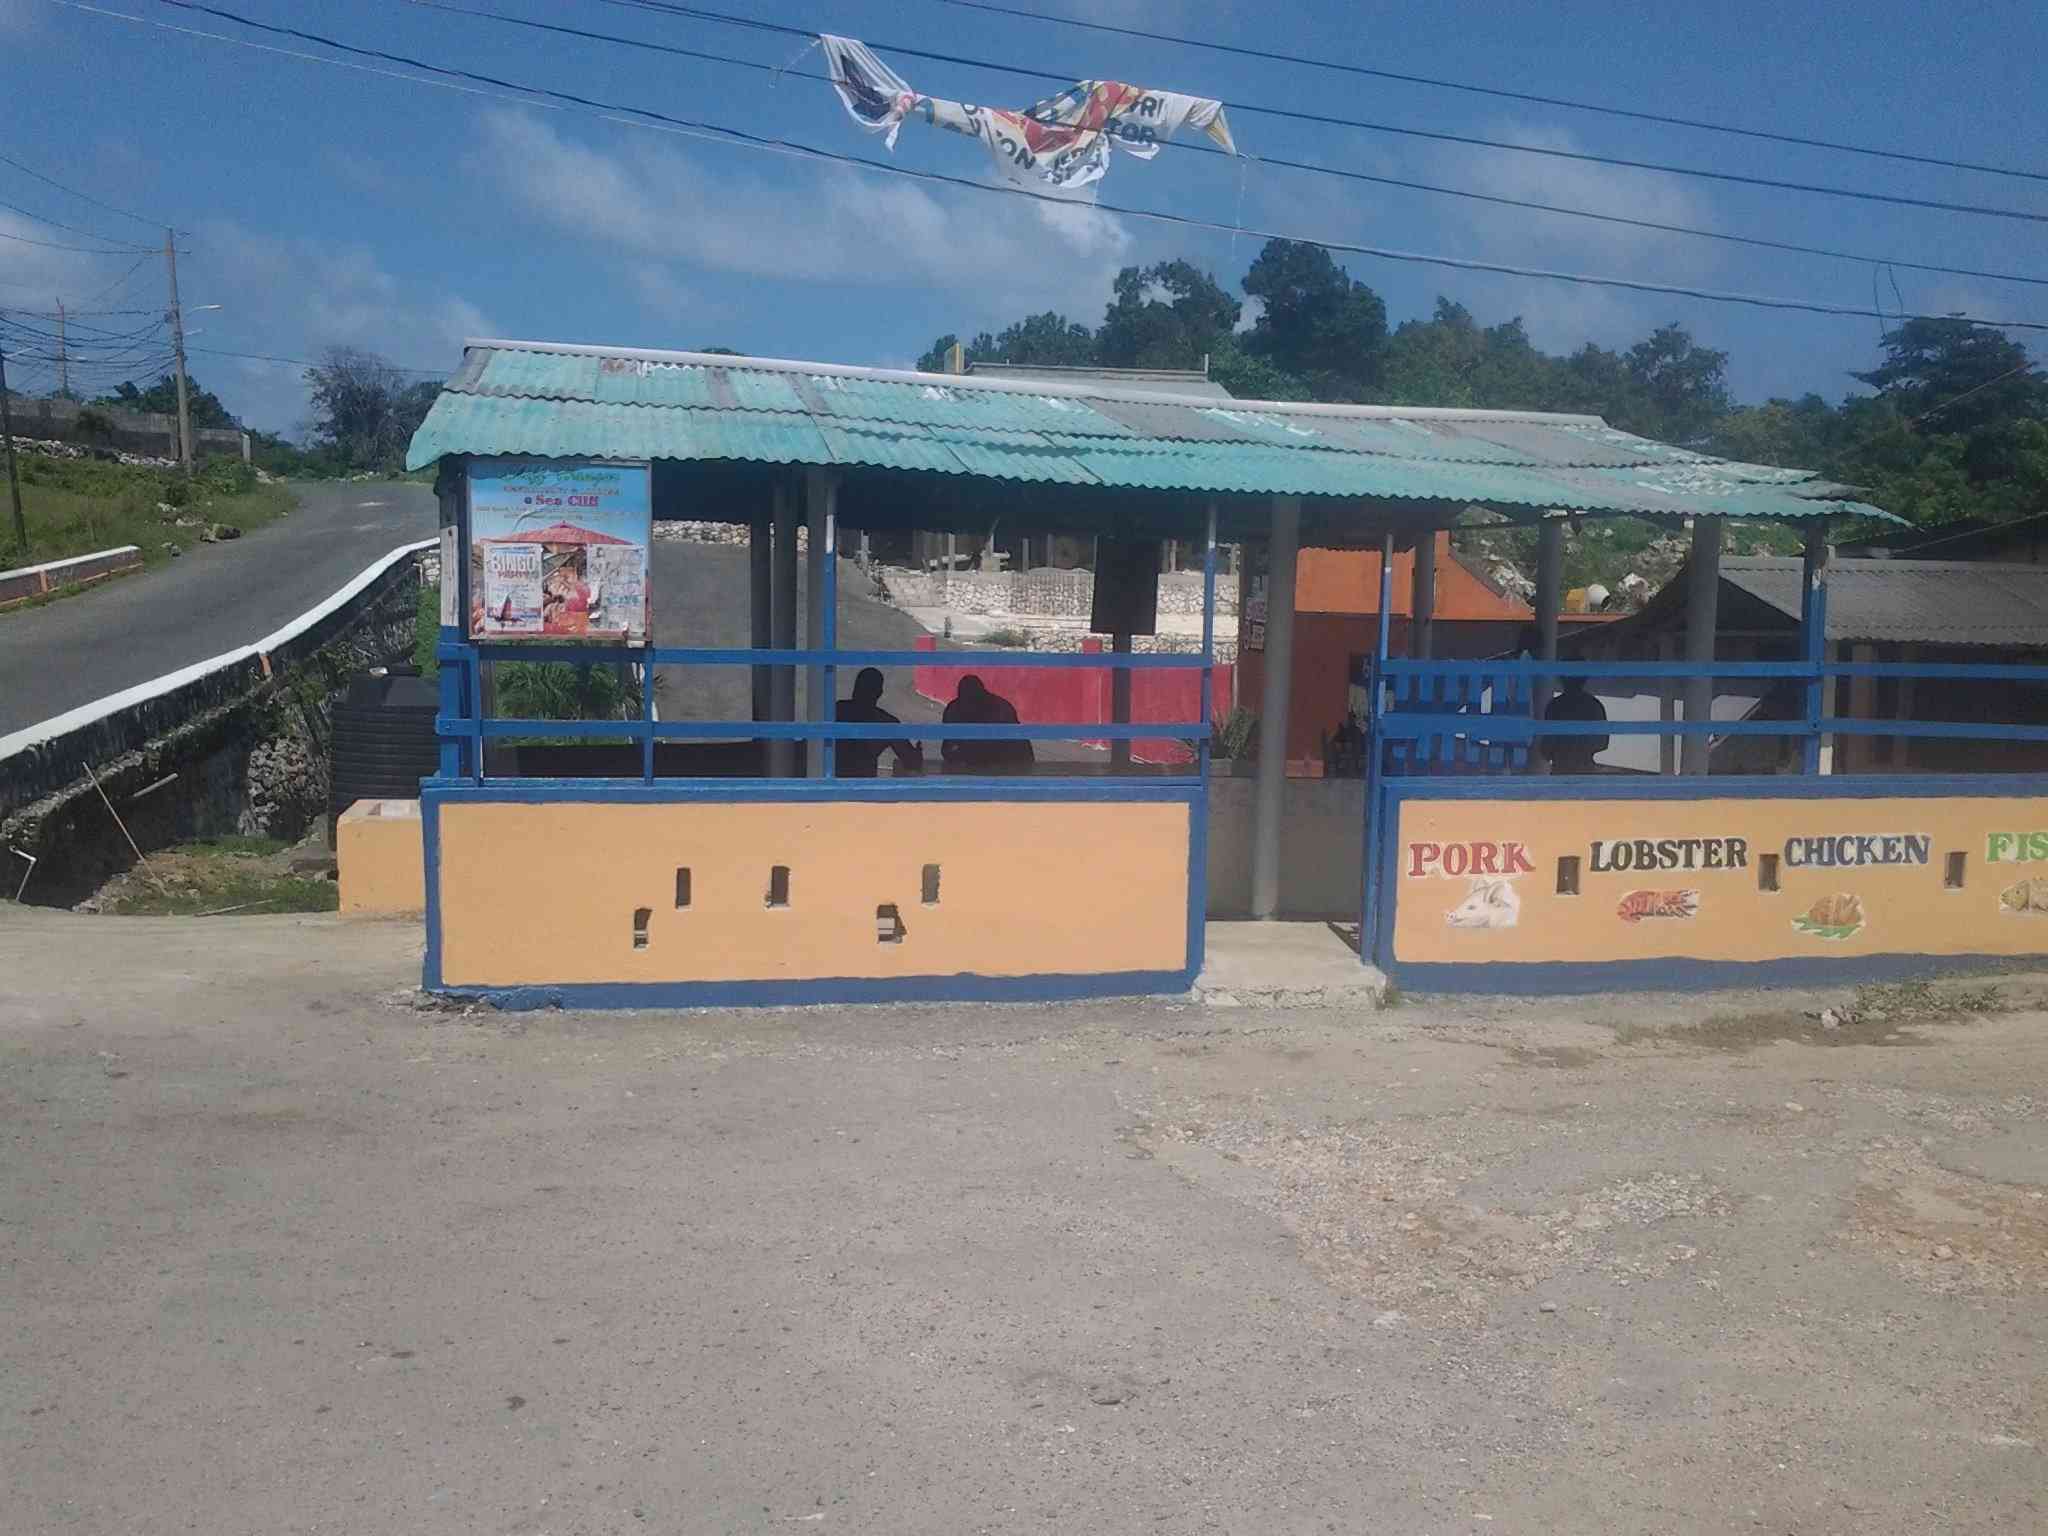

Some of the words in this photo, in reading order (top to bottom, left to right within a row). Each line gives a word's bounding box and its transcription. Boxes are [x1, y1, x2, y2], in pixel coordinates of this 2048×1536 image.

[536, 495, 562, 506] Sea
[1409, 842, 1536, 877] PORK
[1590, 838, 1748, 871] LOBSTER
[1784, 834, 1931, 867] CHICKEN
